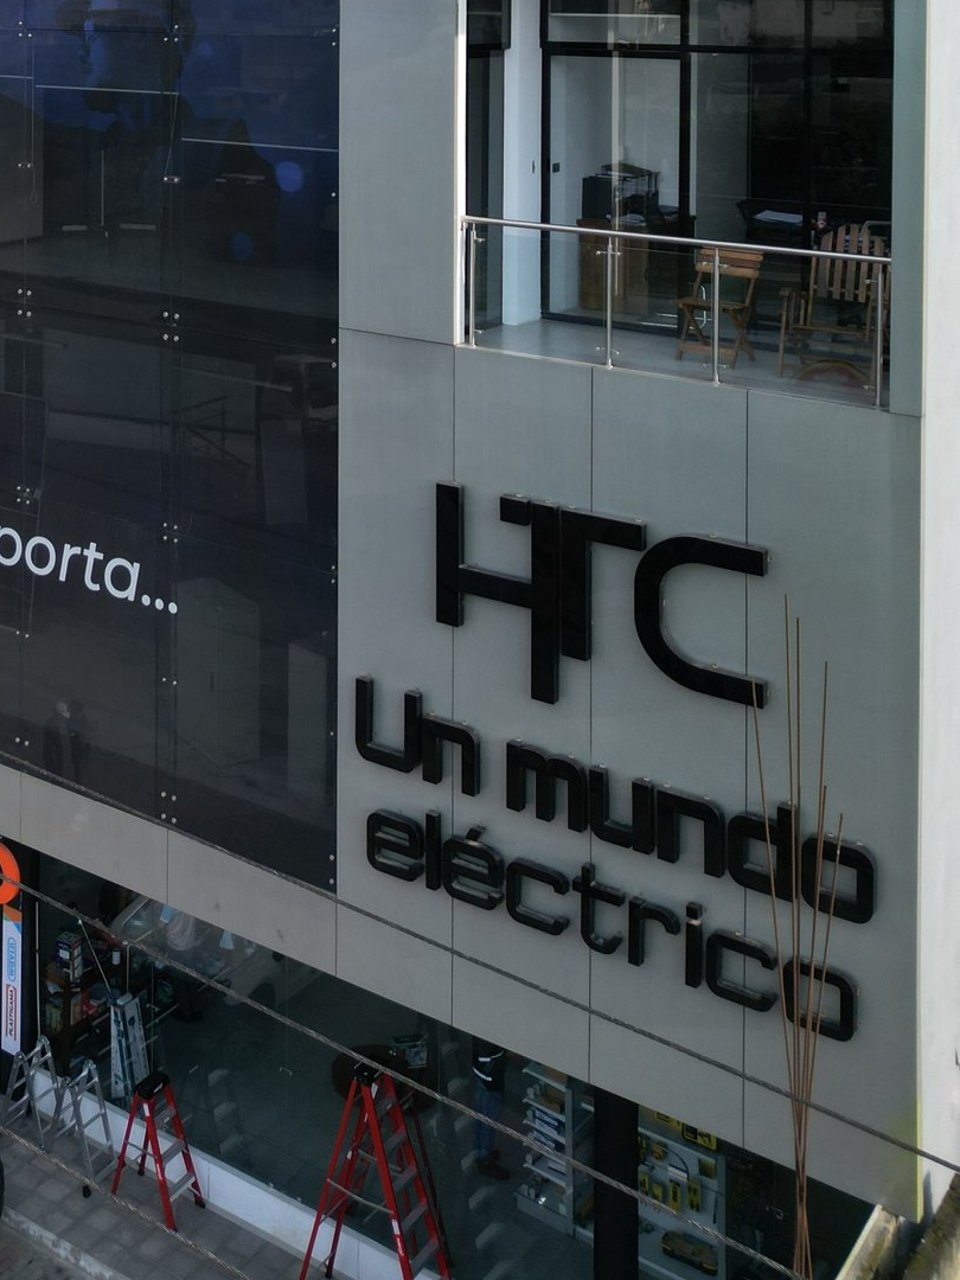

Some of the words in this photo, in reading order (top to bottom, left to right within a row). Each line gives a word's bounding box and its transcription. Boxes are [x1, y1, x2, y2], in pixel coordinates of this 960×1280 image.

[435, 479, 768, 709] HTC
[365, 806, 858, 1042] eléctrico
[506, 738, 877, 924] mundo
